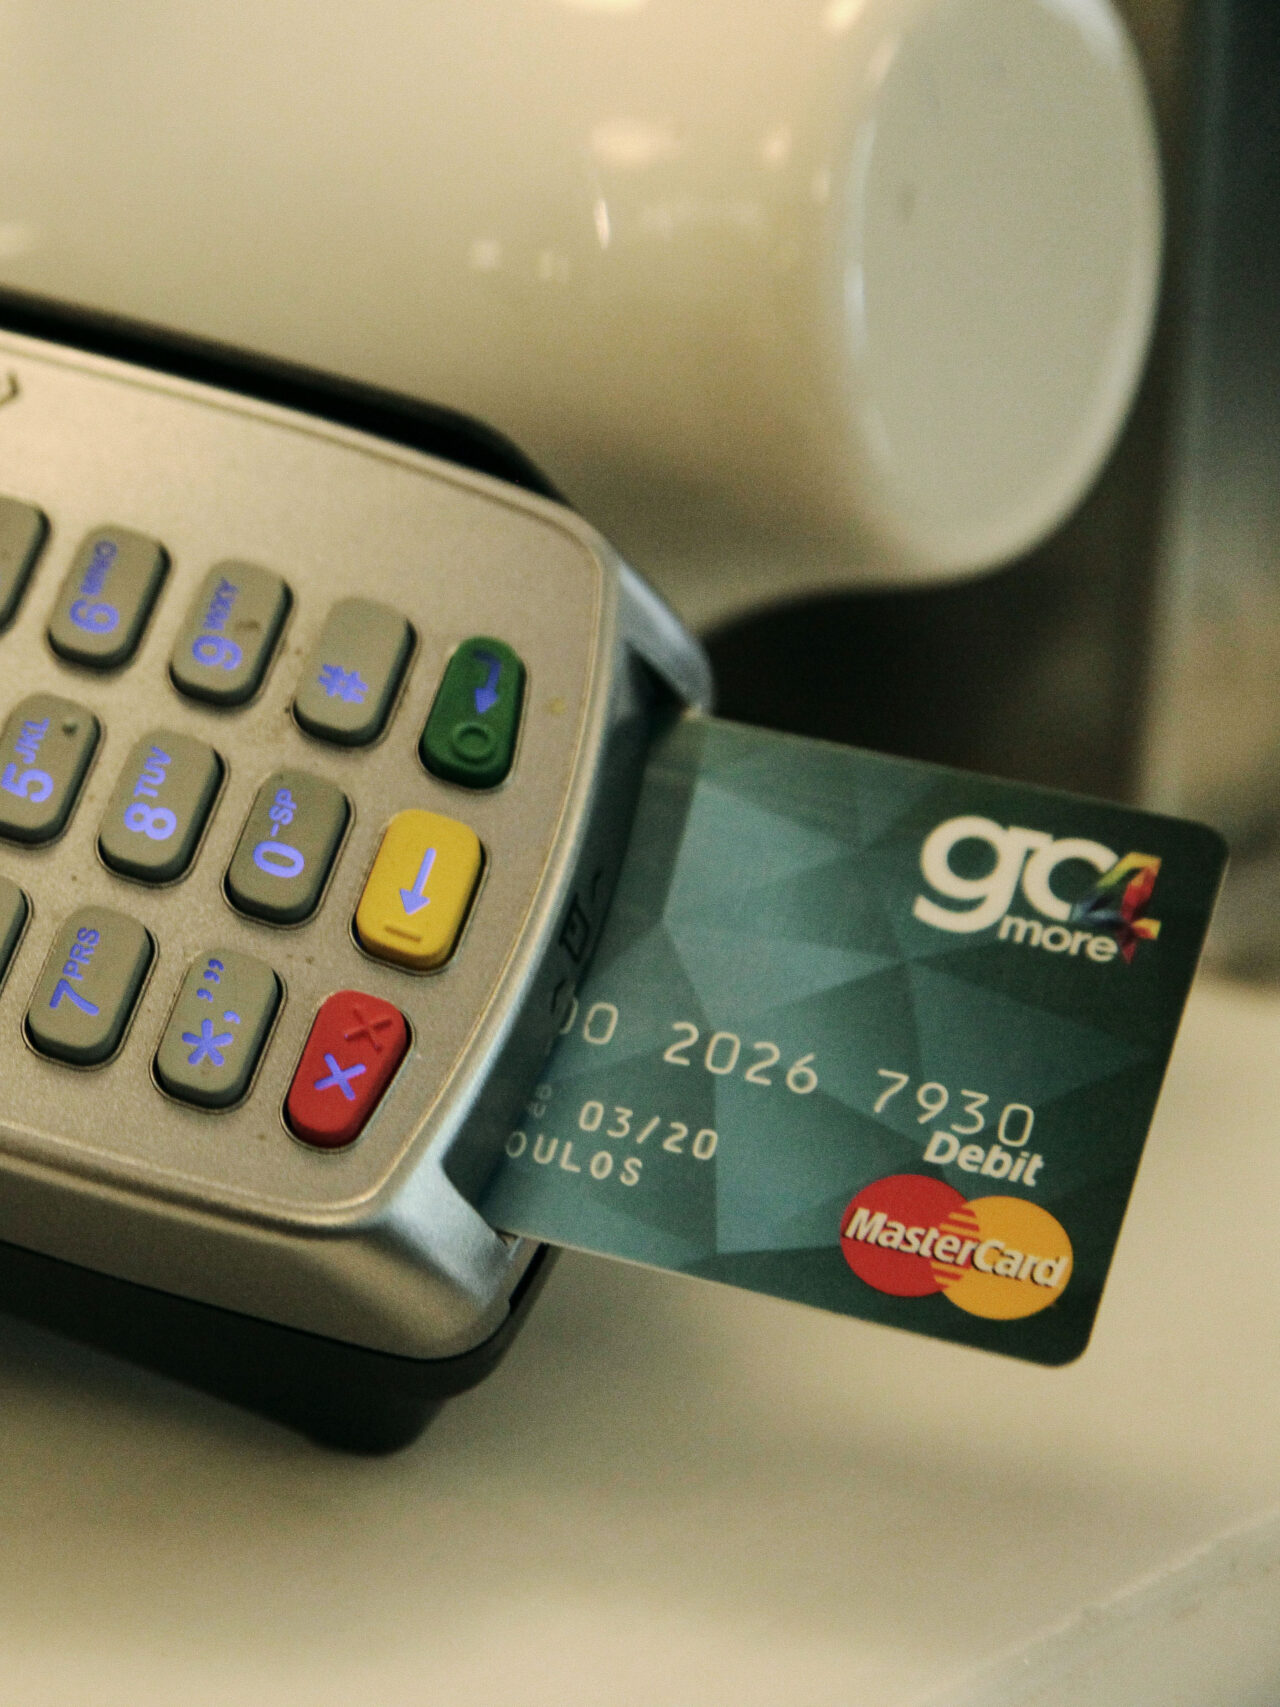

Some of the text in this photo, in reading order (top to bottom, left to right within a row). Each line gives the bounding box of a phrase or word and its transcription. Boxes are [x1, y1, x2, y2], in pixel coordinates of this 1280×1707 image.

[70, 600, 120, 634] 6
[192, 635, 243, 671] 9
[318, 663, 369, 704] #
[0, 717, 54, 803] 5 JKL
[124, 746, 178, 841] 8 TUV
[252, 840, 305, 879] 0
[997, 914, 1119, 963] more
[49, 927, 101, 1017] 7 PRS
[664, 1021, 819, 1096] 2026
[874, 1068, 1035, 1148] 7930
[578, 1100, 719, 1161] 03/20
[922, 1130, 1046, 1188] Debit
[843, 1206, 1071, 1289] MasterCard
